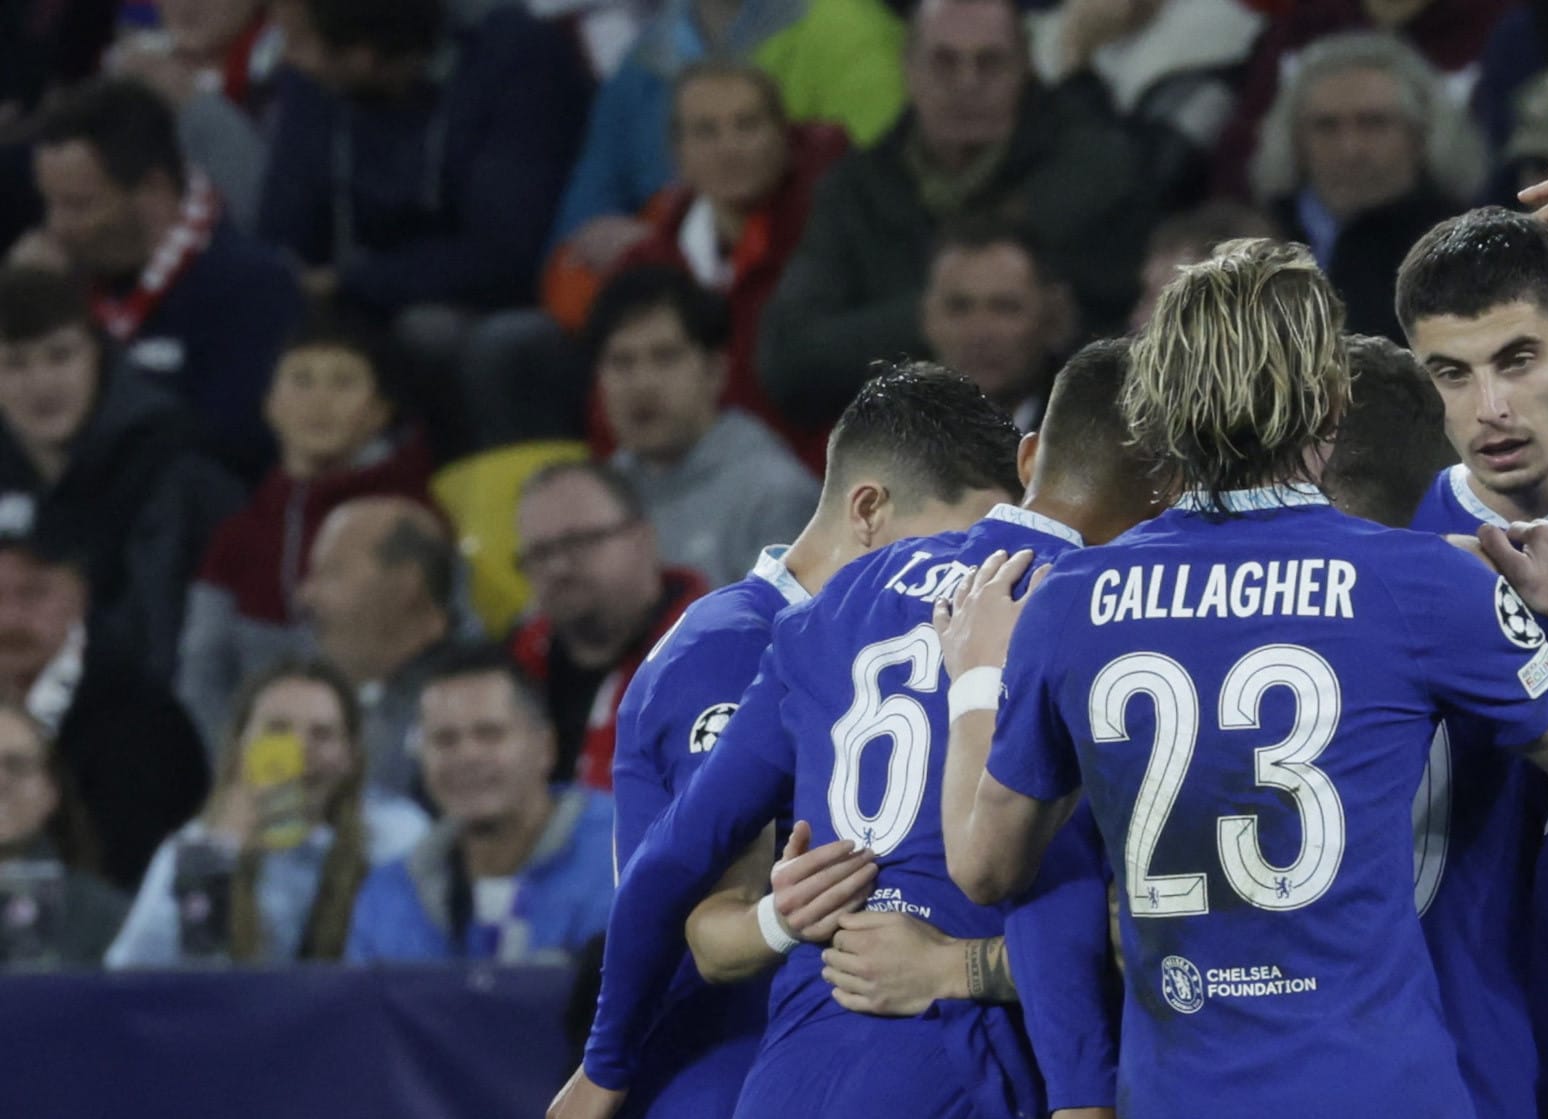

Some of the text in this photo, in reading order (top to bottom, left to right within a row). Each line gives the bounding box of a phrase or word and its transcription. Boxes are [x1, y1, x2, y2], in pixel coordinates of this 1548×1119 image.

[1090, 559, 1356, 625] GALLAGHER
[827, 623, 945, 857] 6
[1089, 644, 1345, 917] 23
[1207, 966, 1282, 982] CHELSEA
[1207, 978, 1317, 998] FOUNDATION
